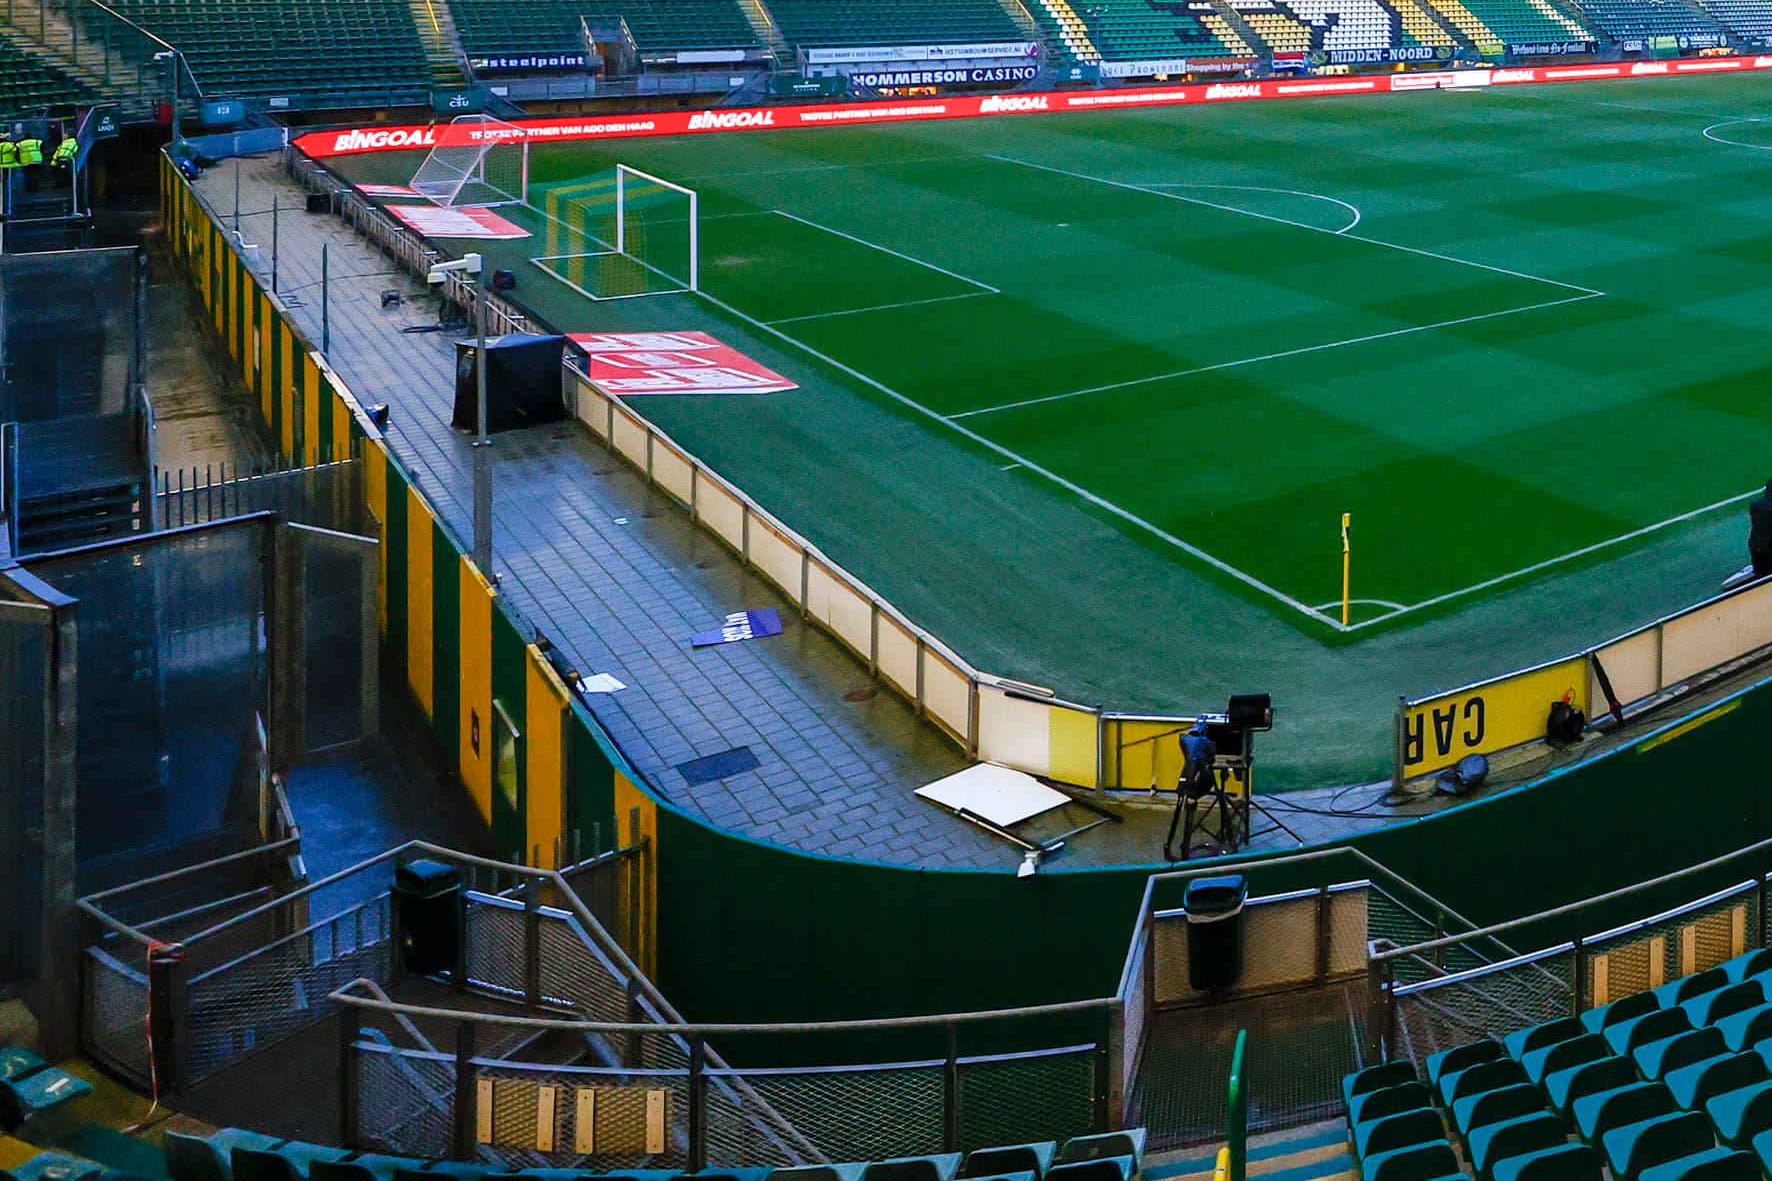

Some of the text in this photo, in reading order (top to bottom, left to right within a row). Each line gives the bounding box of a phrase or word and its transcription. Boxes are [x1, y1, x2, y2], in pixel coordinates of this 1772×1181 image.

[489, 55, 585, 68] steelpoint
[1331, 47, 1433, 63] MIDDEN-NOORD
[1186, 63, 1221, 73] Shopping
[852, 67, 1035, 87] HOMMERSON CASINO
[1205, 84, 1262, 99] BINGOAL
[980, 95, 1048, 112] BINGOAL
[561, 124, 582, 134] VAN
[583, 123, 604, 133] ADO
[605, 123, 626, 132] DEN
[627, 121, 655, 131] HAAG
[688, 110, 774, 129] BINGOAL
[333, 129, 436, 152] BINGOAL
[1405, 696, 1485, 765] CAR
